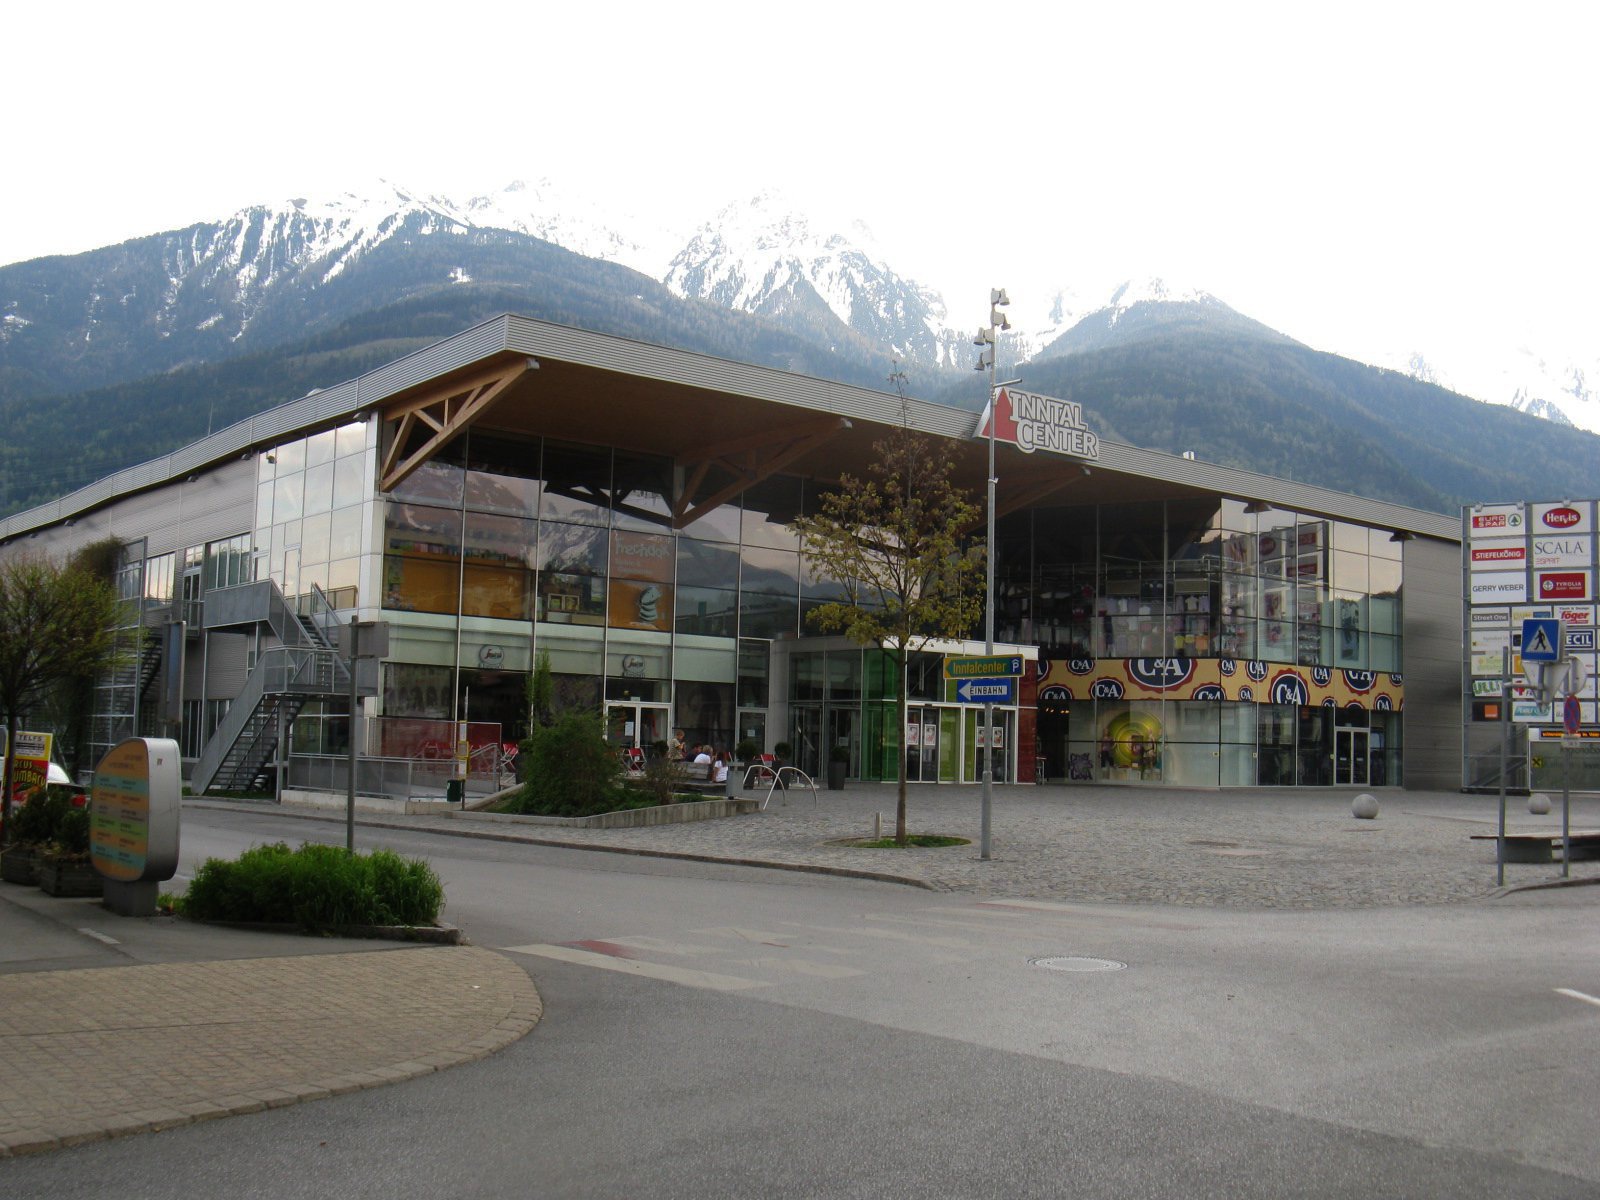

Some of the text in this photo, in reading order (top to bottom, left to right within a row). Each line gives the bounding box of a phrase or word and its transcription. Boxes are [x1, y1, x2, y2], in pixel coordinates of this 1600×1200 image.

[1008, 391, 1088, 431] INNTAL
[1017, 420, 1098, 458] CENTER
[1546, 512, 1578, 524] Hervis
[1475, 550, 1522, 560] STIEFELKÖNIG
[1534, 541, 1584, 555] SCALA
[1472, 583, 1525, 593] GERRY WEBER
[1566, 634, 1592, 645] ECIL
[953, 661, 1007, 675] Inntalcenter
[1071, 659, 1090, 670] C&A
[1137, 658, 1185, 676] C&A
[969, 686, 1004, 695] EINBAHN
[1096, 684, 1119, 698] C&A
[1276, 683, 1302, 705] C&A
